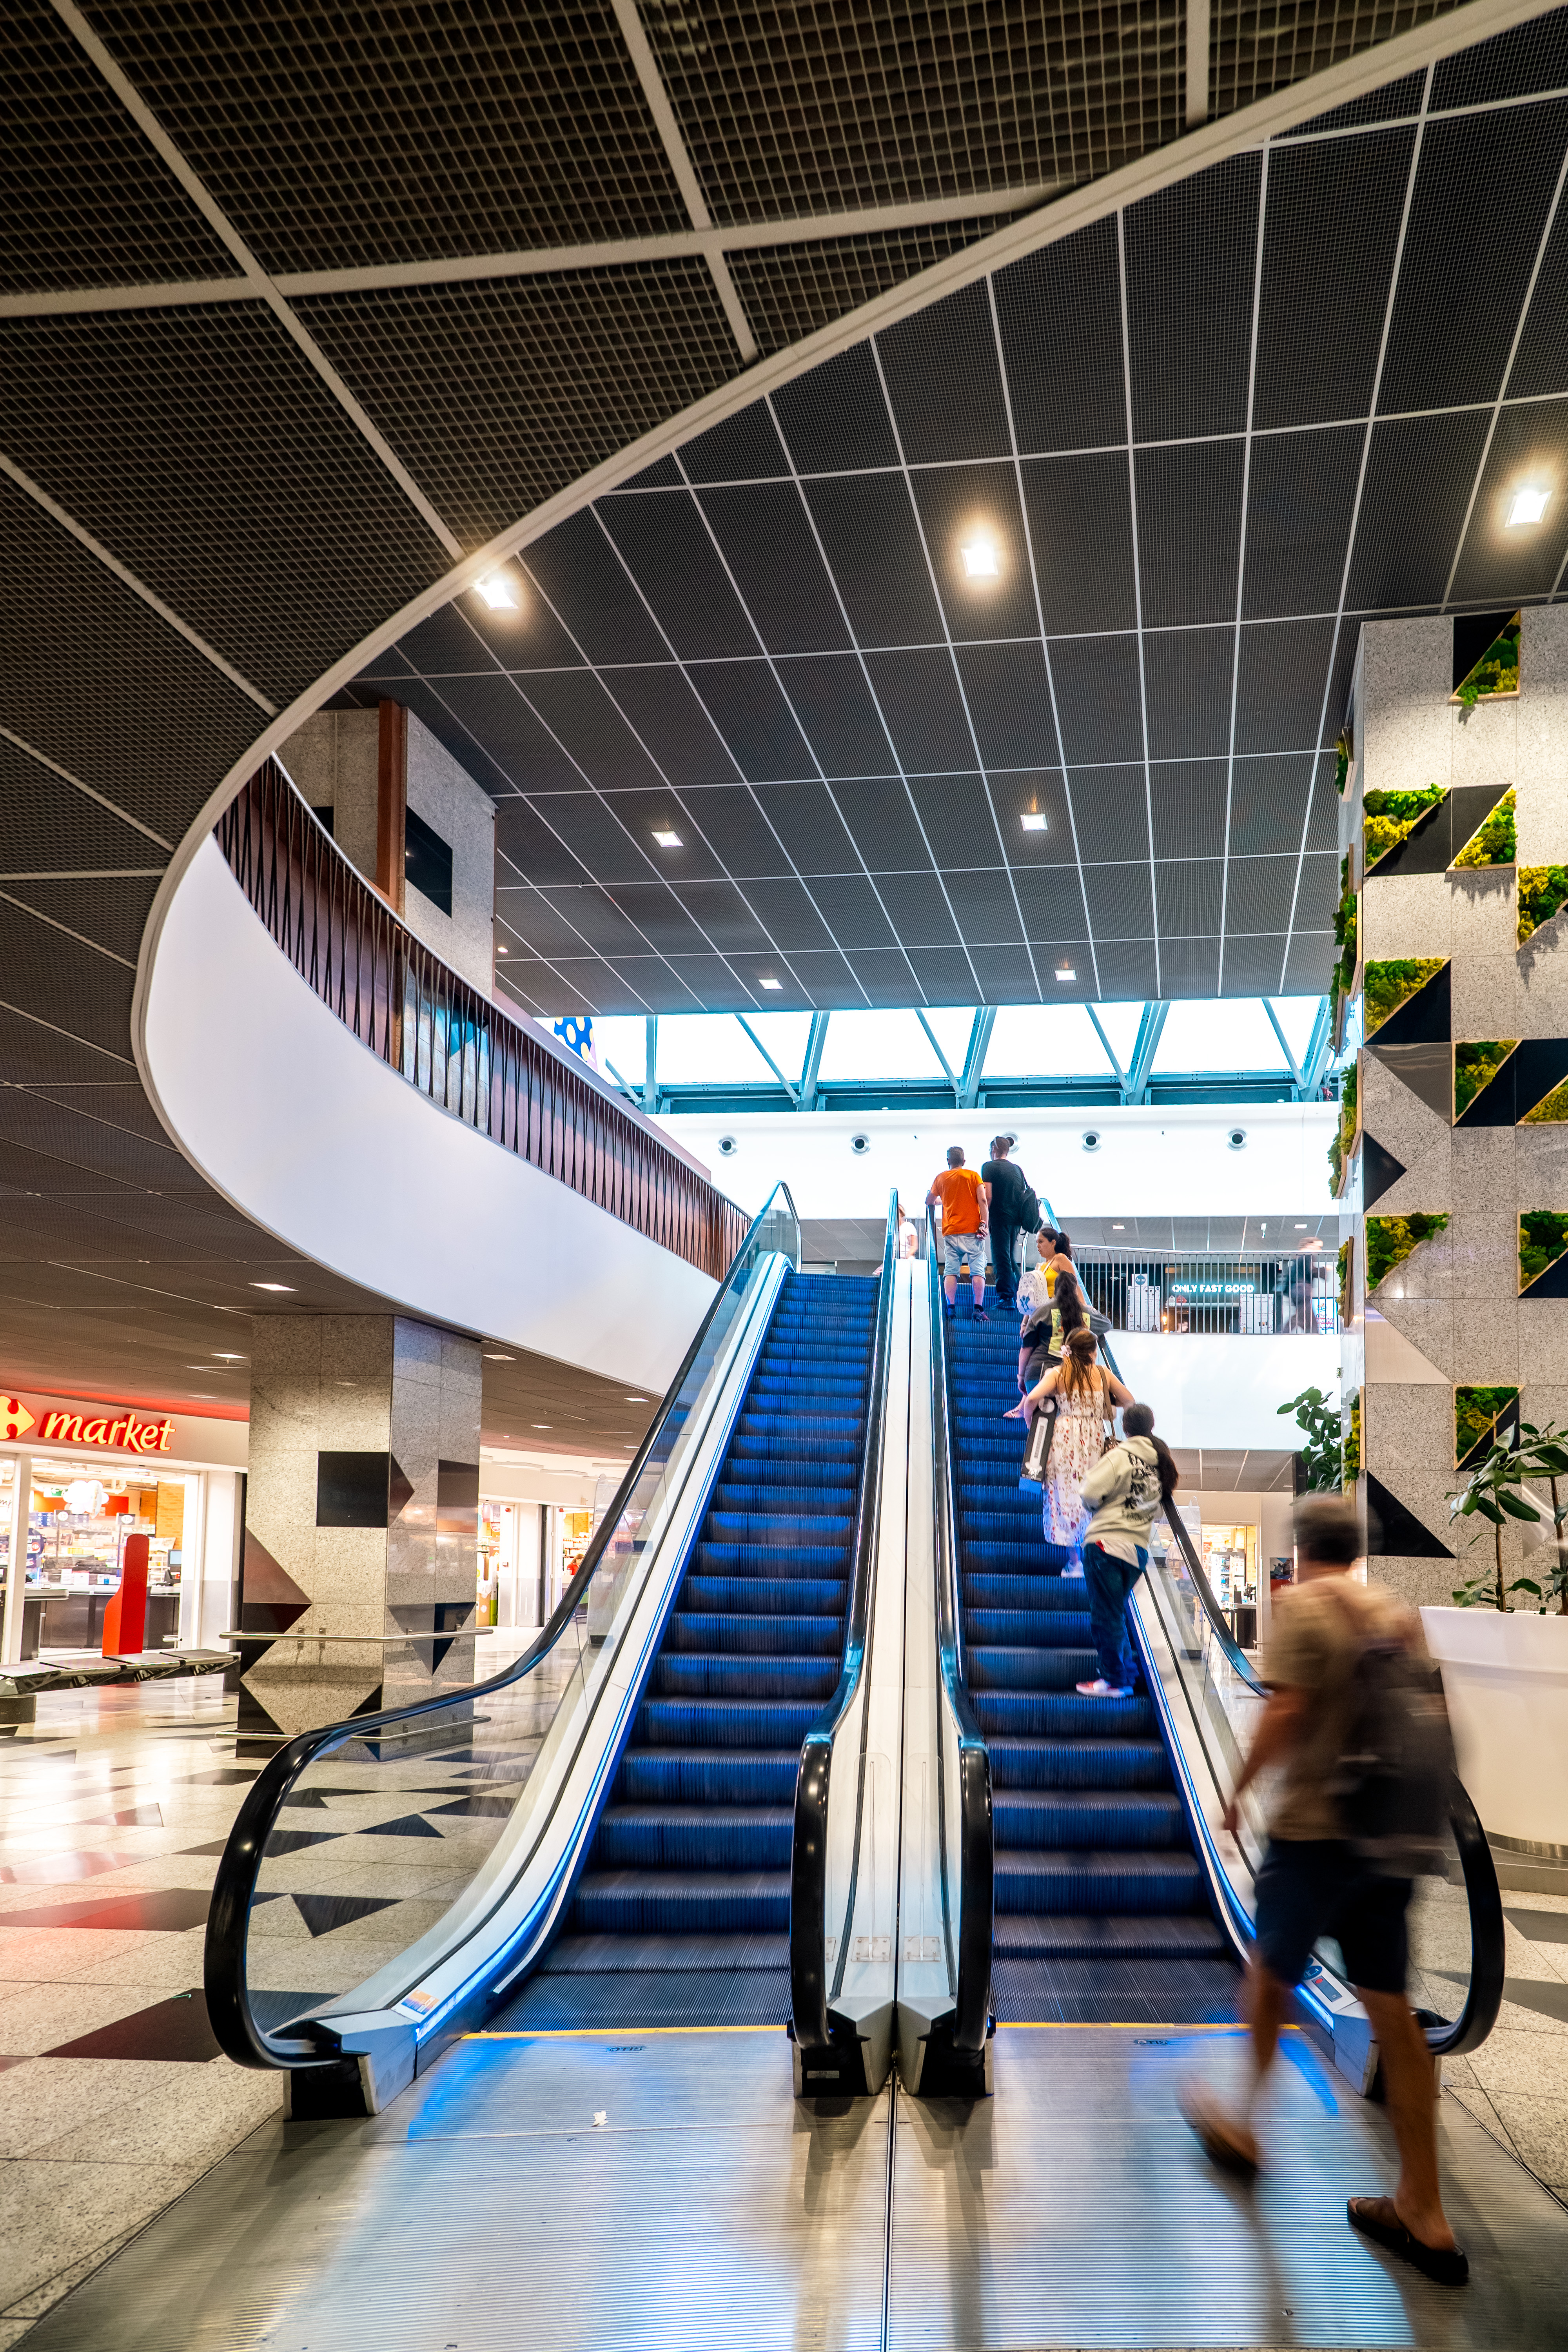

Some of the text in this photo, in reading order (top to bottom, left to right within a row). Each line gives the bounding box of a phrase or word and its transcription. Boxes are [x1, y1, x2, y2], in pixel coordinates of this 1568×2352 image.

[1172, 1284, 1254, 1293] ONLY FAST GOOD
[41, 1412, 176, 1453] market
